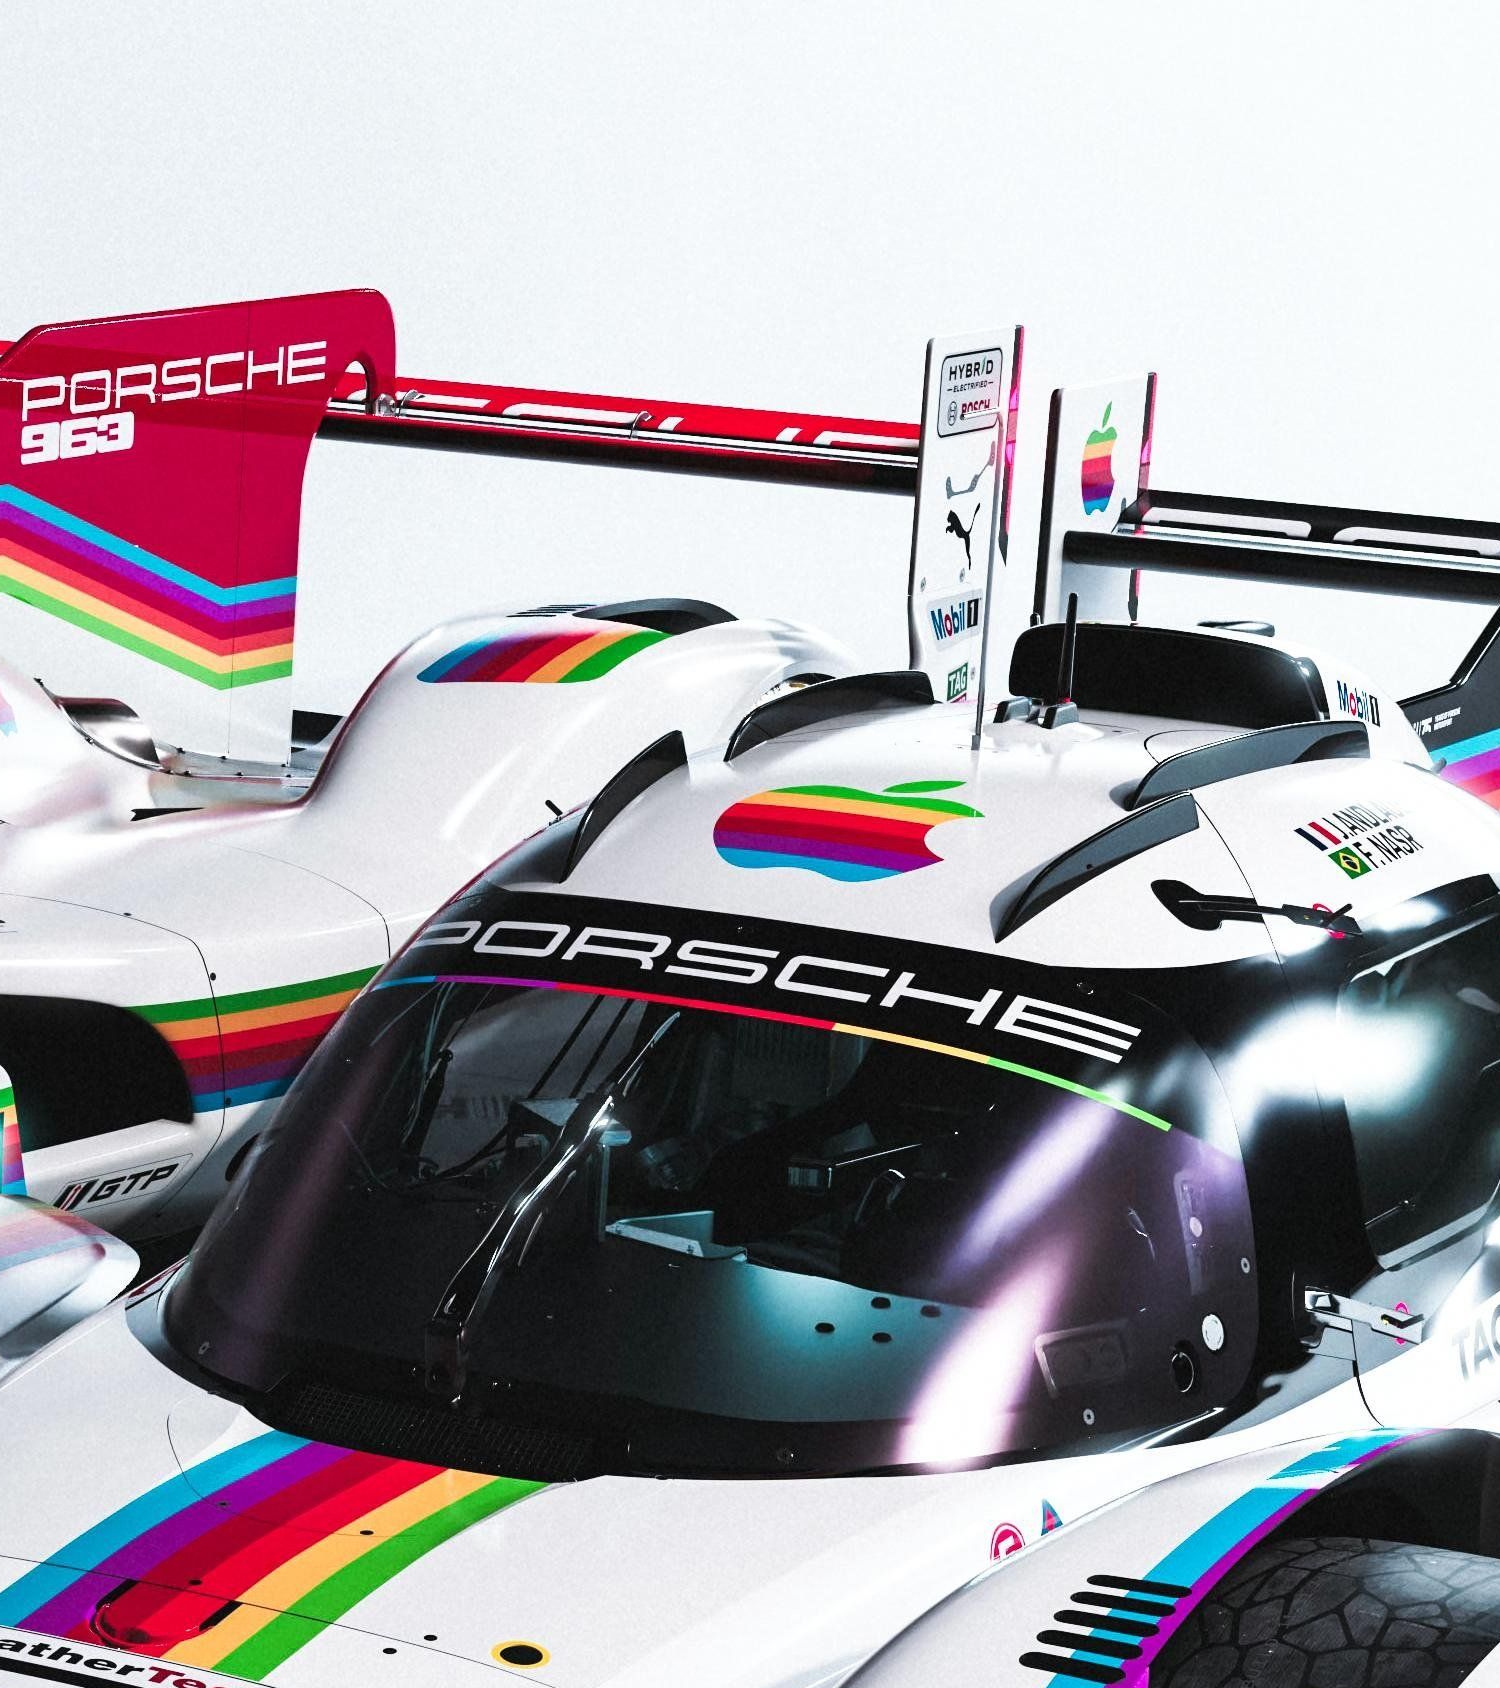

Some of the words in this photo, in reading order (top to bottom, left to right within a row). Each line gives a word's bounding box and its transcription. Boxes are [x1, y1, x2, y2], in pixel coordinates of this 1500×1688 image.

[20, 340, 327, 422] PORSCHE
[20, 411, 135, 465] 963
[931, 600, 966, 641] Mobil
[949, 666, 968, 698] TAG
[1337, 680, 1370, 722] Mobil
[1366, 824, 1425, 863] NASR
[87, 1162, 179, 1203] GTP
